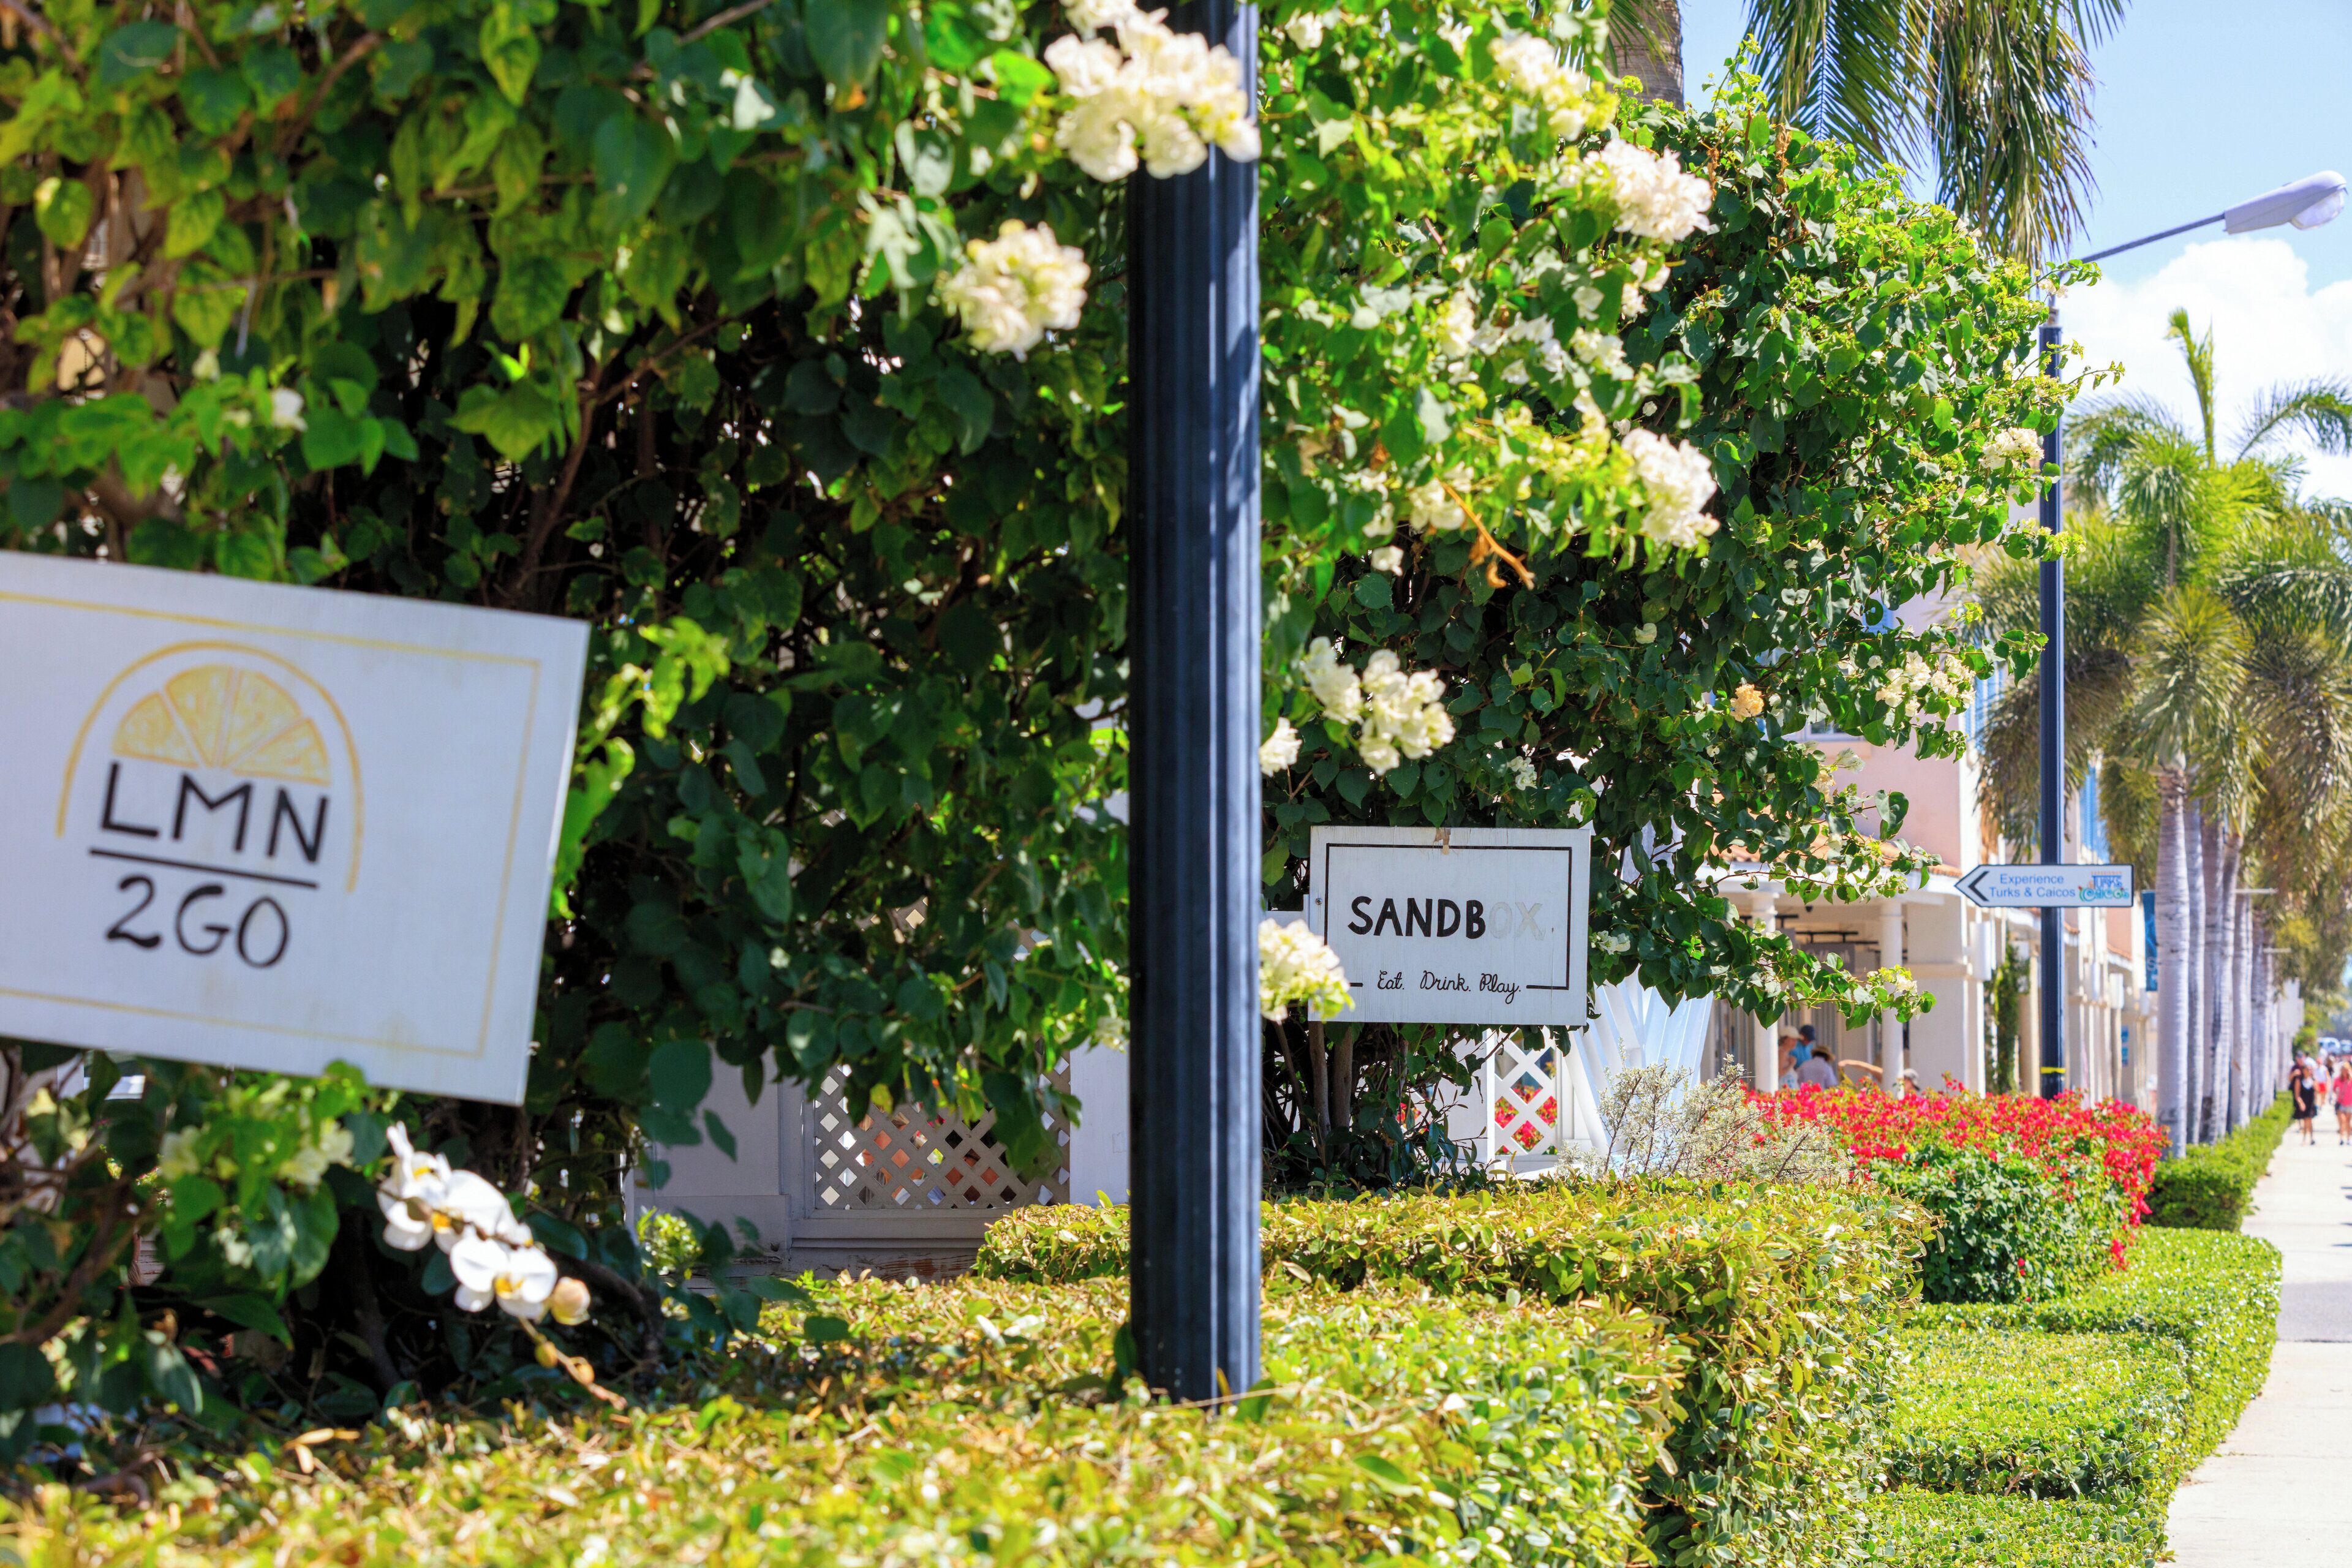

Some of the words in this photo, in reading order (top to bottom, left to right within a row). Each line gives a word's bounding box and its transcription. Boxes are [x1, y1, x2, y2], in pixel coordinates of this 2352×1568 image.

[99, 761, 330, 864] LMN
[1989, 887, 2020, 897] Turks
[2024, 887, 2032, 897] &
[2037, 887, 2076, 897] Caicos
[2000, 873, 2064, 886] Experience
[105, 874, 290, 969] 2GO
[1377, 970, 1405, 991] Eat.
[1420, 970, 1471, 992] Drink.
[1479, 973, 1521, 1005] Play.
